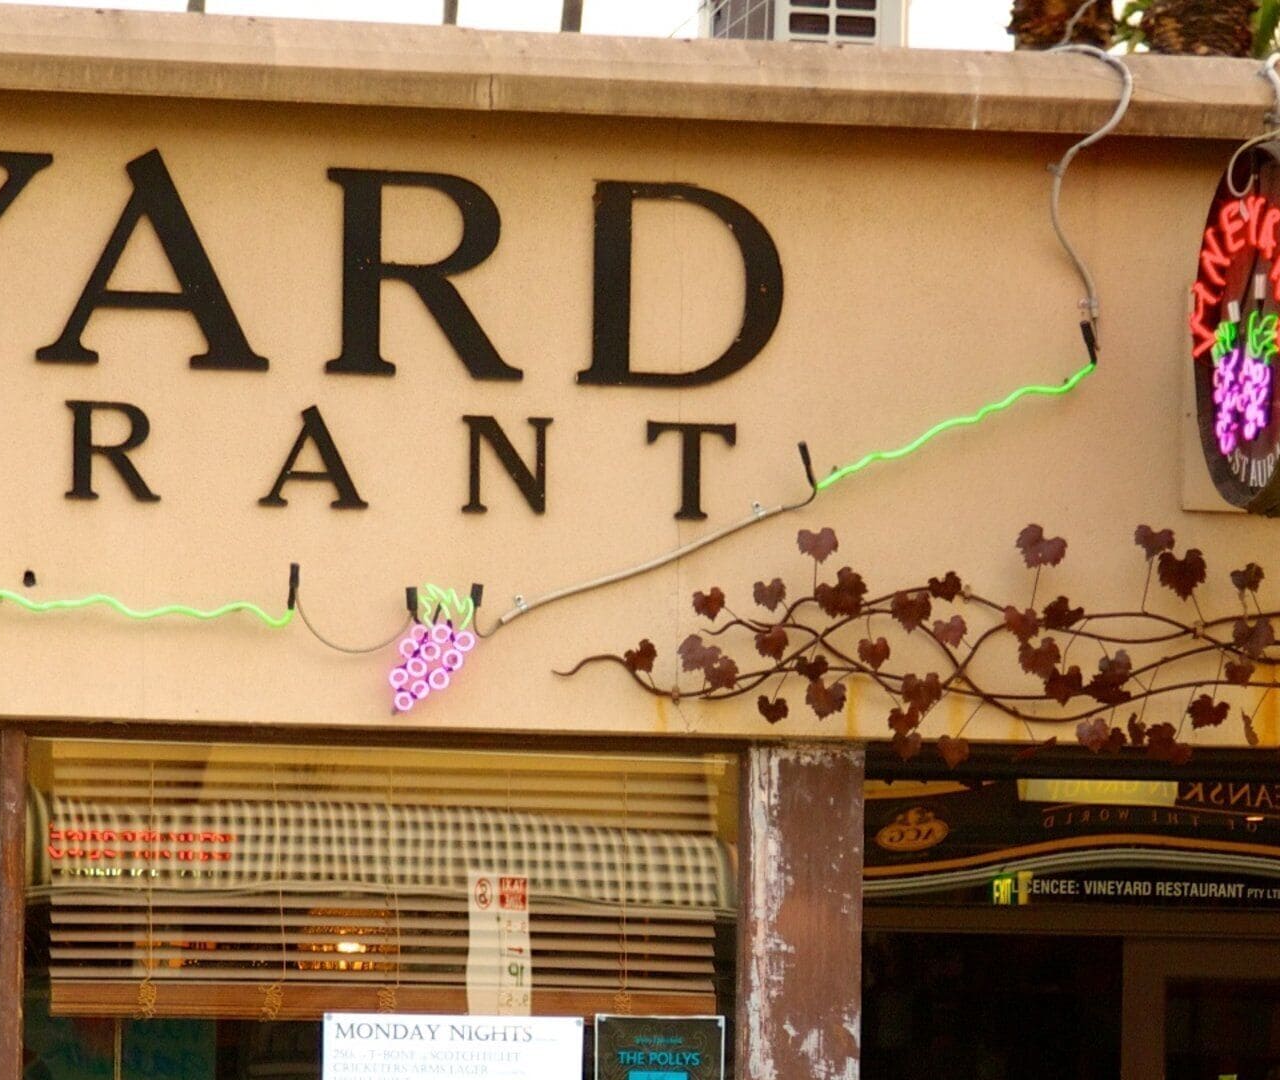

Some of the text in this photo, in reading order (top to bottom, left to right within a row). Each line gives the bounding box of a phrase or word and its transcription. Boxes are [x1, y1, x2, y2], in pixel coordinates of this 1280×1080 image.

[1012, 879, 1079, 894] LCENCEE:
[1084, 880, 1151, 895] VINEYARD
[1156, 882, 1245, 898] RESTAURANT
[1247, 889, 1264, 898] PTY
[335, 1022, 533, 1042] MONDAY NIGHTS
[619, 1052, 700, 1066] THE POLLYS
